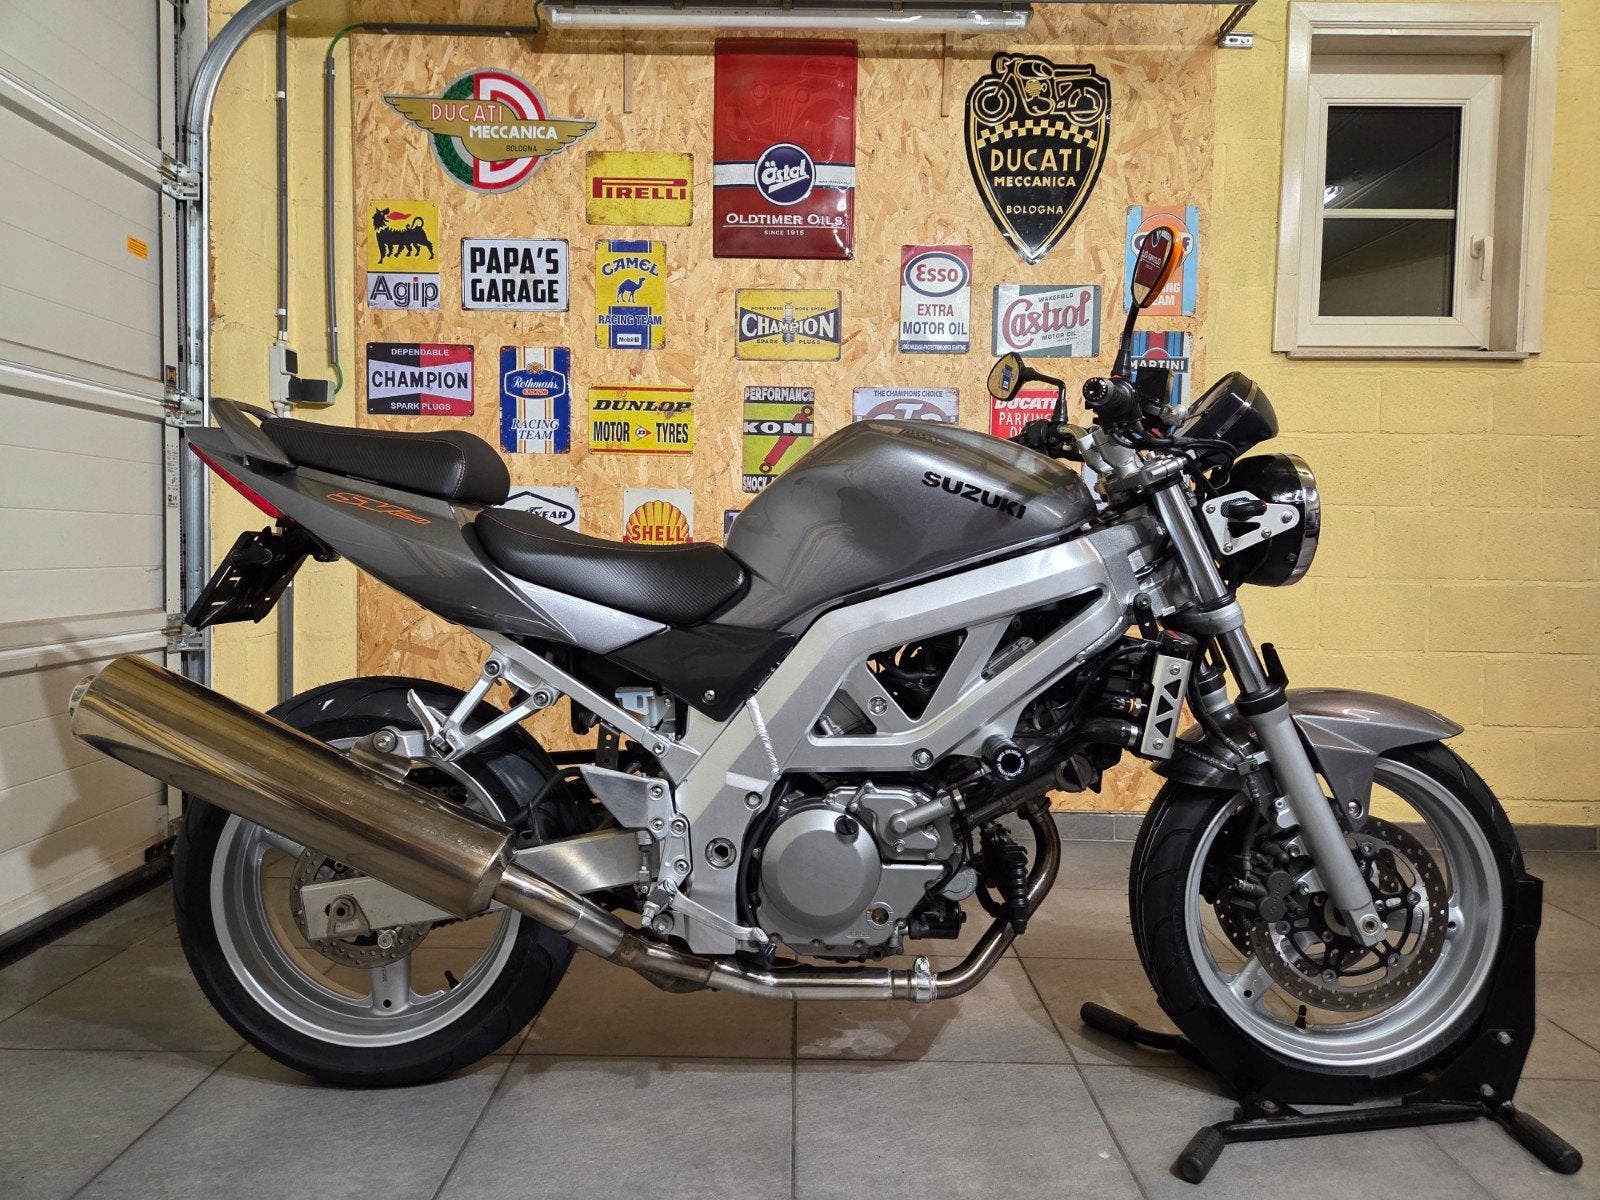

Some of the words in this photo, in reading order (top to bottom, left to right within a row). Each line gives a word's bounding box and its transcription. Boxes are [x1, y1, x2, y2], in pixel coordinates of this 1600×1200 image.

[431, 103, 503, 122] DUCATI
[469, 125, 558, 140] MECCANICA
[506, 145, 538, 153] BOLOGNA
[990, 148, 1081, 172] DUCATI
[993, 176, 1077, 187] MECCANICA
[592, 177, 688, 200] PIRELLI
[1006, 205, 1064, 215] BOLOGNA
[726, 213, 803, 225] OLDTIMER
[470, 246, 560, 274] PAPA'S
[601, 257, 659, 277] CAMEL
[369, 275, 439, 308] Agip
[470, 278, 559, 303] GARAGE
[1038, 292, 1074, 302] WAKEFIELD
[917, 303, 955, 316] EXTRA
[598, 314, 635, 325] RACING
[636, 314, 662, 325] TEAM
[741, 312, 835, 338] CHAMPION
[1002, 290, 1092, 350] Castrol
[902, 321, 945, 335] MOTOR
[948, 322, 968, 335] OIL
[1042, 332, 1065, 341] MOTOR
[391, 348, 449, 356] DEPENDABLE
[1131, 359, 1185, 370] MARTINI
[372, 370, 468, 389] CHAMPION
[744, 387, 815, 402] PERFORMANCE
[886, 390, 921, 398] CHAMPIONS
[921, 390, 943, 398] CHOICE
[390, 402, 420, 410] SPARK
[421, 403, 451, 411] PLUGS
[593, 399, 692, 412] DUNLOP
[994, 397, 1058, 410] DUCATI
[511, 418, 560, 430] RACING
[743, 421, 813, 434] KONI
[518, 429, 553, 440] TEAM
[593, 421, 630, 442] MOTOR
[656, 422, 689, 443] TYRES
[921, 470, 1027, 520] SUZUKI
[631, 525, 685, 541] SHELL
